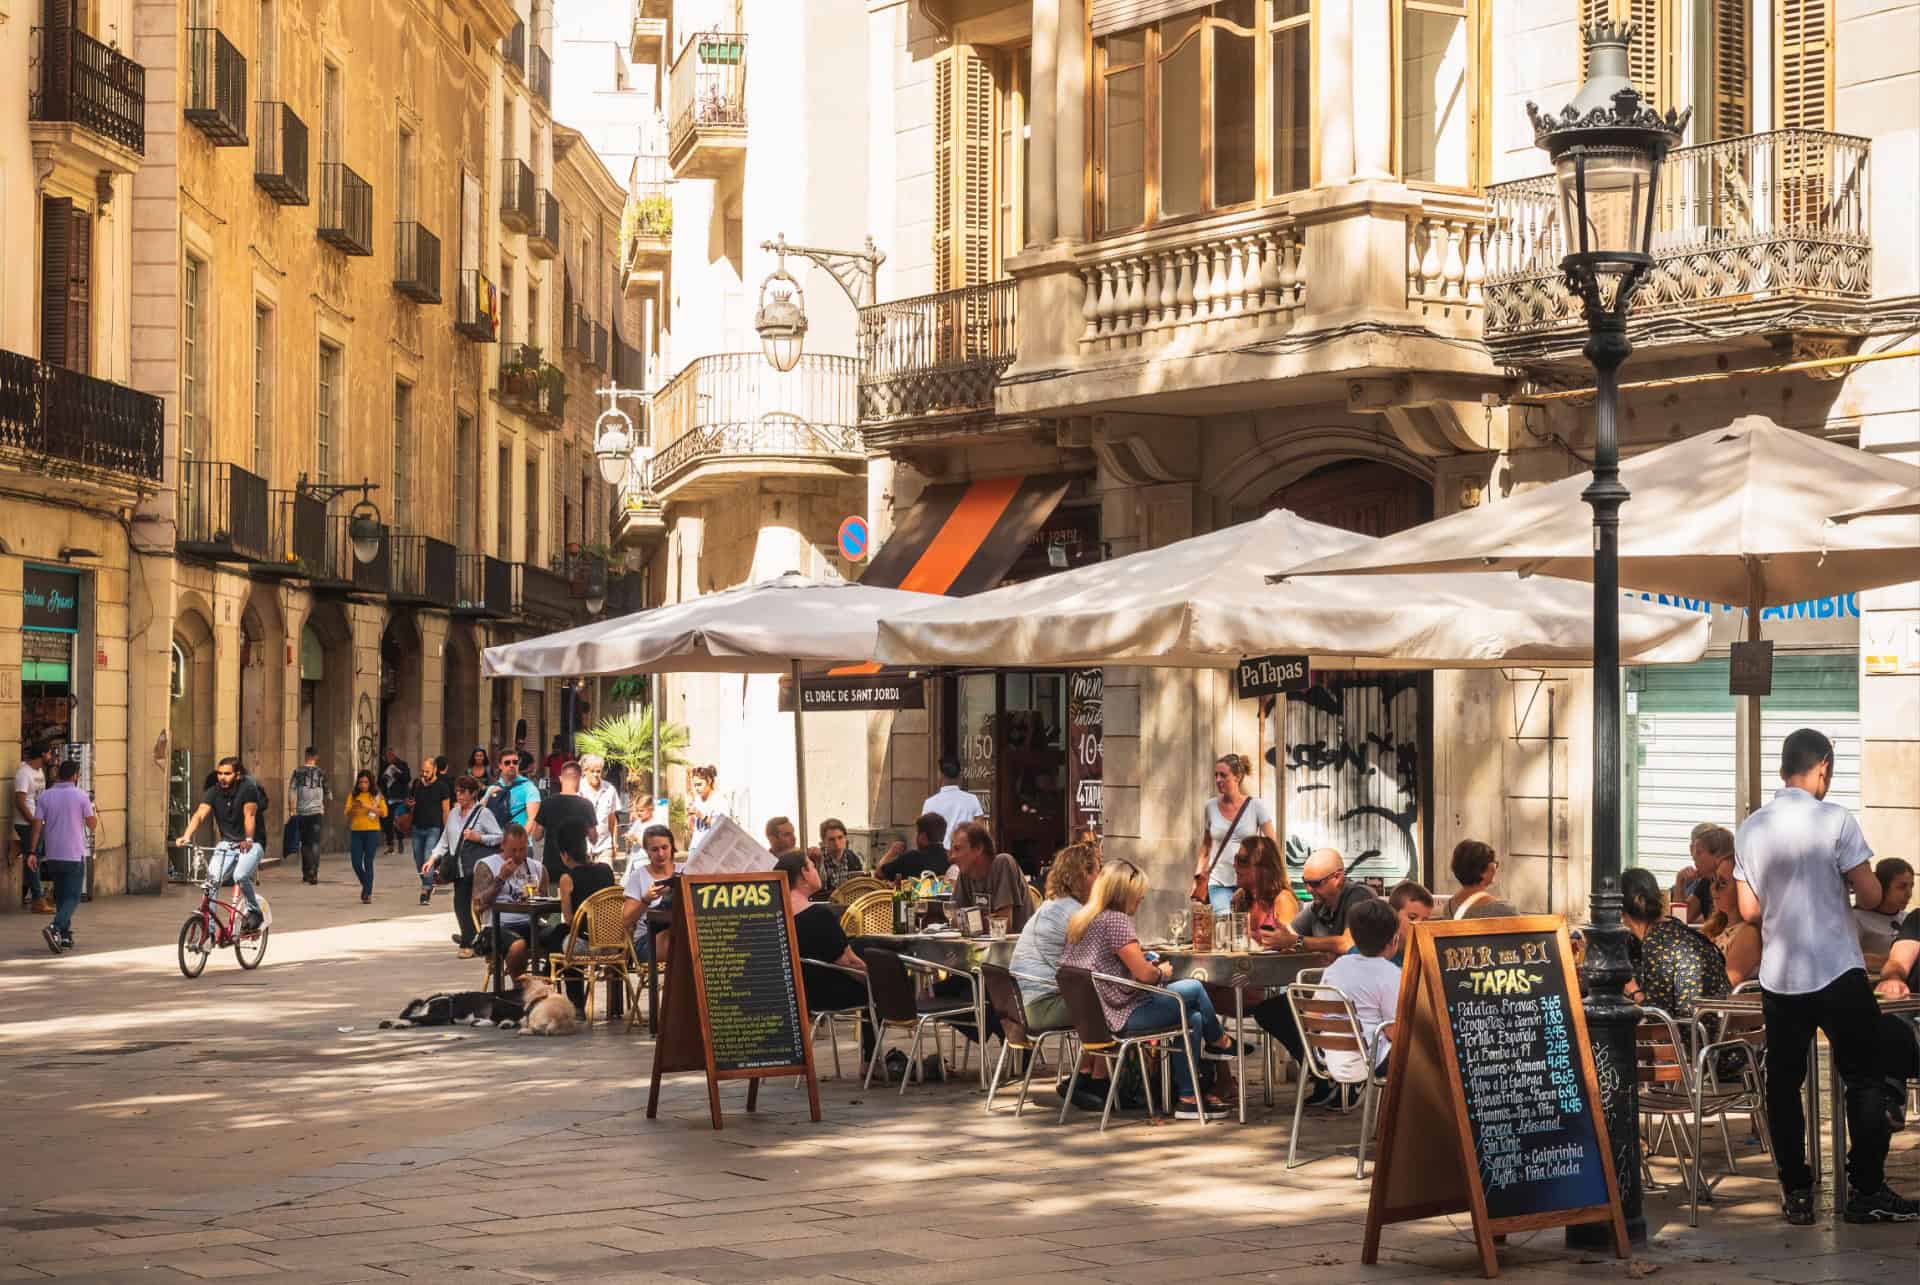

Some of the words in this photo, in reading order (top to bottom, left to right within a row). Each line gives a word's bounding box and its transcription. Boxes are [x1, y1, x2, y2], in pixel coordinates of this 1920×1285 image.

[804, 690, 814, 702] EL
[815, 690, 837, 702] DRAC
[838, 690, 849, 702] DE
[851, 689, 872, 701] SANT
[874, 687, 900, 701] JORDI
[697, 884, 771, 909] TAPAS
[1470, 969, 1532, 995] TAPAS
[1457, 1000, 1499, 1017] Patatas
[1500, 998, 1538, 1015] Bravas
[1458, 1016, 1506, 1034] Croquetas
[1460, 1030, 1495, 1048] Tortilla
[1468, 1062, 1508, 1077] Calamares
[1515, 1059, 1547, 1073] Romana
[1560, 1098, 1583, 1113] 4.95
[1516, 1115, 1561, 1134] Artesanal
[1547, 1160, 1580, 1178] Colada
